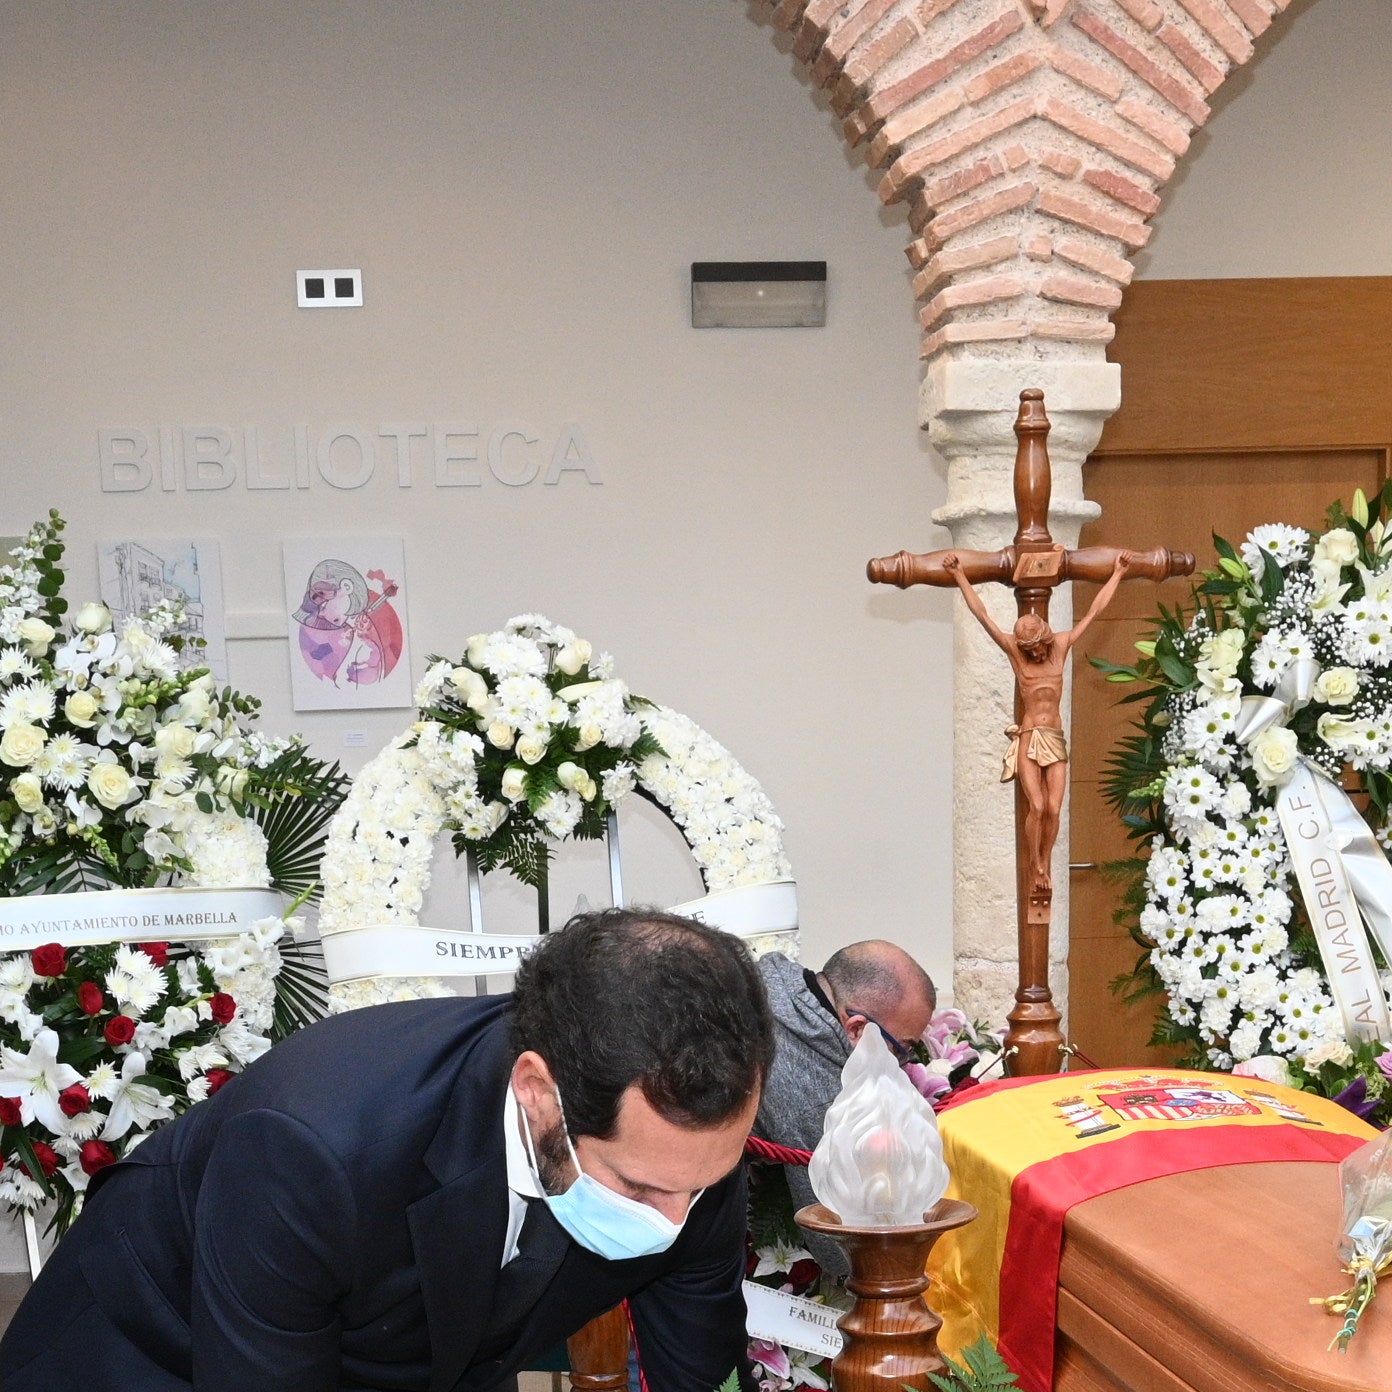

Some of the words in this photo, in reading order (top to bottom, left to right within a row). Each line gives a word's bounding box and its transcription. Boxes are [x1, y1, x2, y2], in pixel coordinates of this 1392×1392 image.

[97, 424, 605, 494] BIBLIOTECA
[1288, 784, 1320, 841] C.F.
[20, 915, 139, 934] AYUNTAMIENTO
[142, 914, 161, 927] DE
[164, 911, 239, 927] MARBELLA
[1311, 857, 1362, 975] MADRID
[435, 941, 531, 960] SIEMPR
[1351, 988, 1382, 1044] EAL
[789, 1306, 838, 1331] FAMILI
